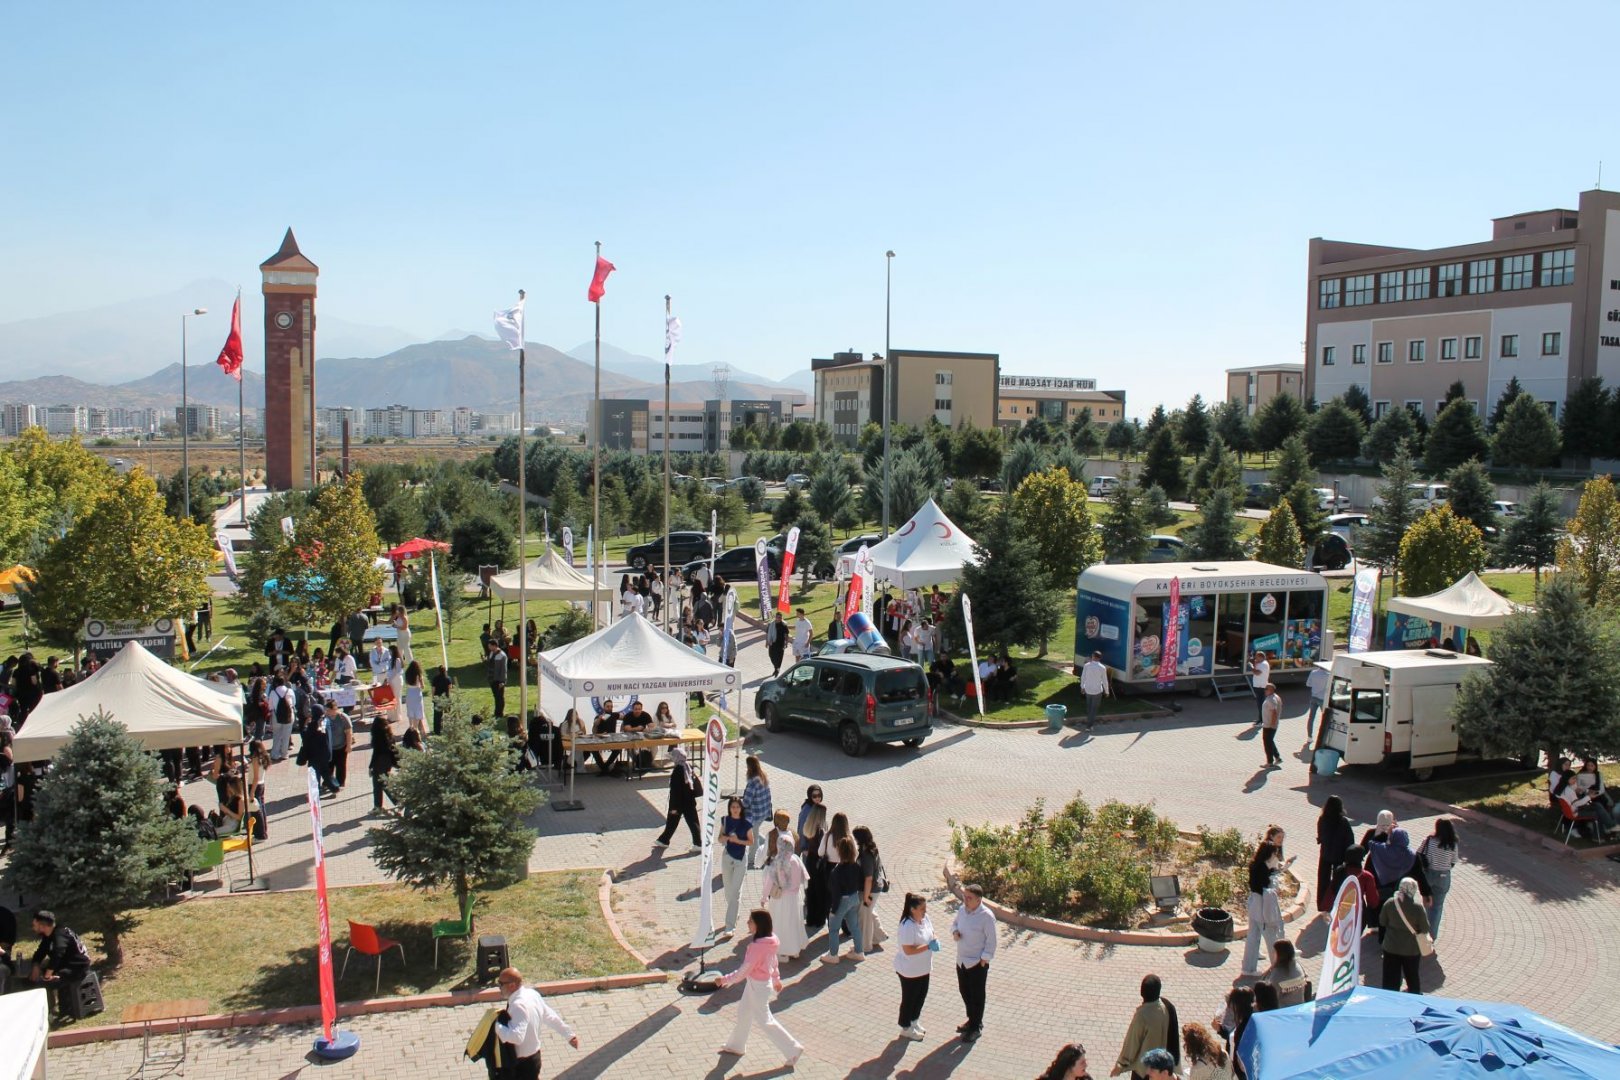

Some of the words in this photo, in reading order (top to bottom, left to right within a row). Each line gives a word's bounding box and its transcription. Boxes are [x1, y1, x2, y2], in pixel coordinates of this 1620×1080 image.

[1600, 335, 1620, 348] TASA
[1156, 582, 1196, 590] KAERİ
[91, 640, 123, 650] POLİTİKA
[623, 682, 639, 690] NACİ
[668, 679, 713, 688] ÜNİVERSİTESİ
